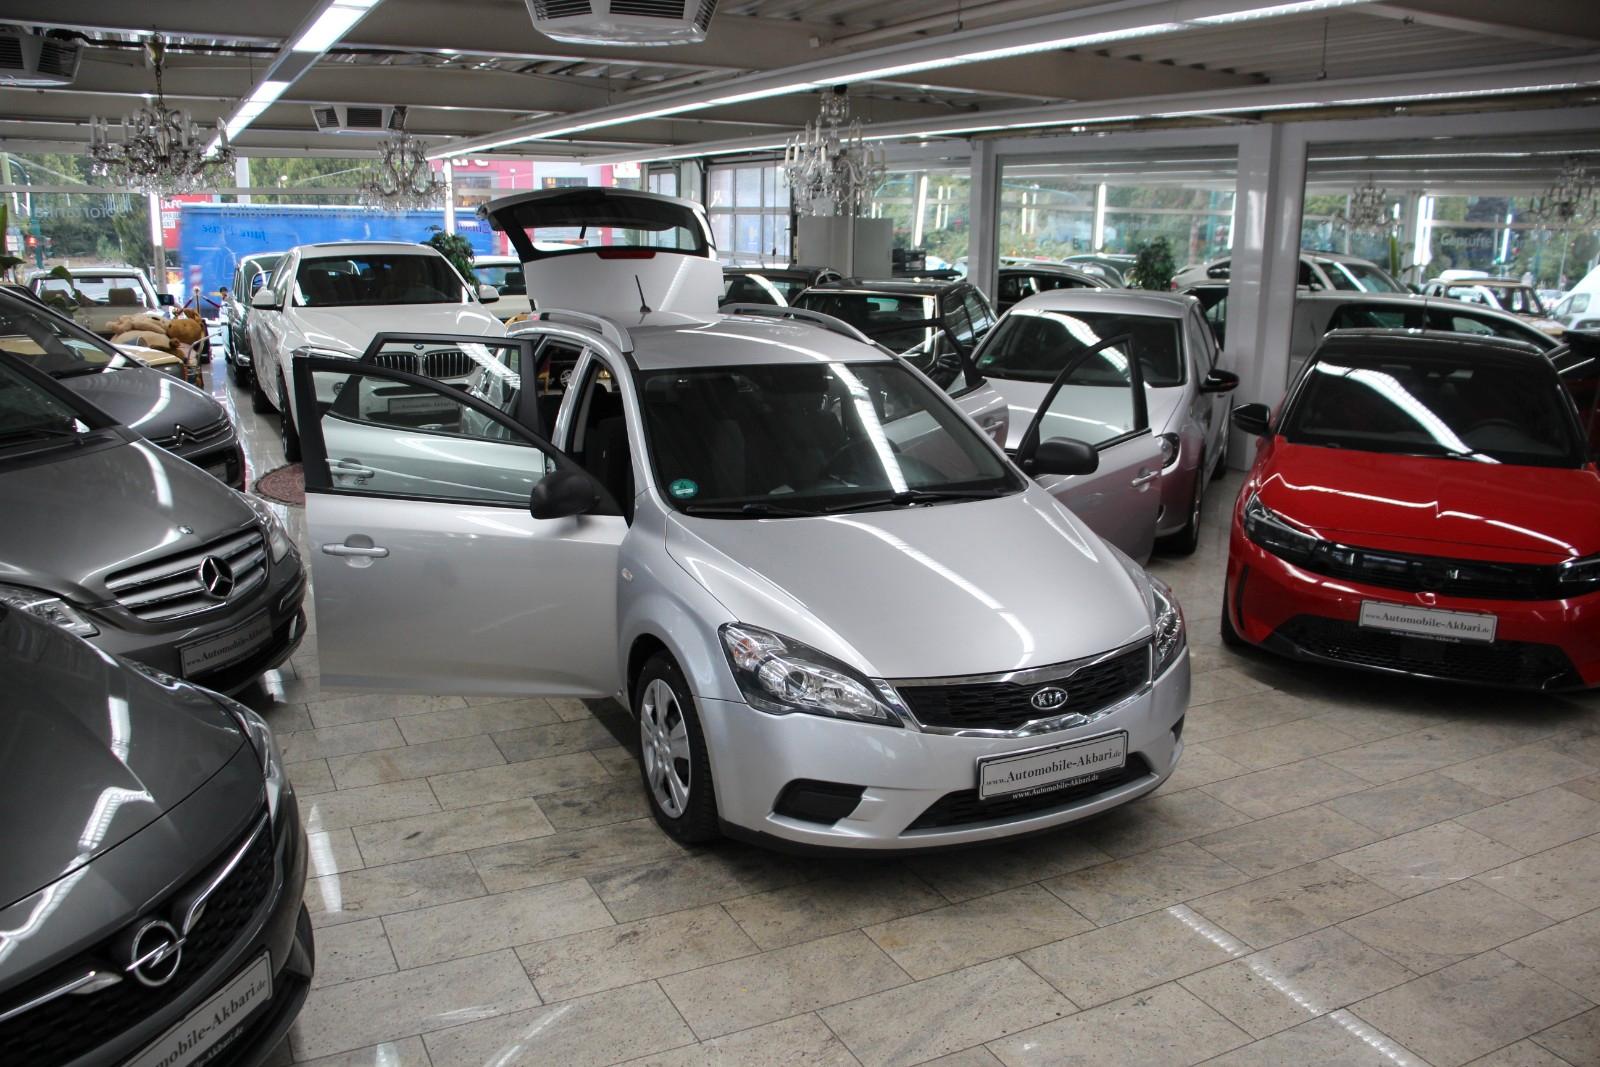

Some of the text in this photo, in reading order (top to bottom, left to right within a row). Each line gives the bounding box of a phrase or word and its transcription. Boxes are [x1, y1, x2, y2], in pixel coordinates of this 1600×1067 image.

[1365, 611, 1489, 634] www.Automobile-Akbari.de
[1037, 691, 1065, 707] KIA
[985, 748, 1122, 787] www.Automobile-Akbari.de
[1011, 773, 1100, 800] www.Automobile-Akbari.de
